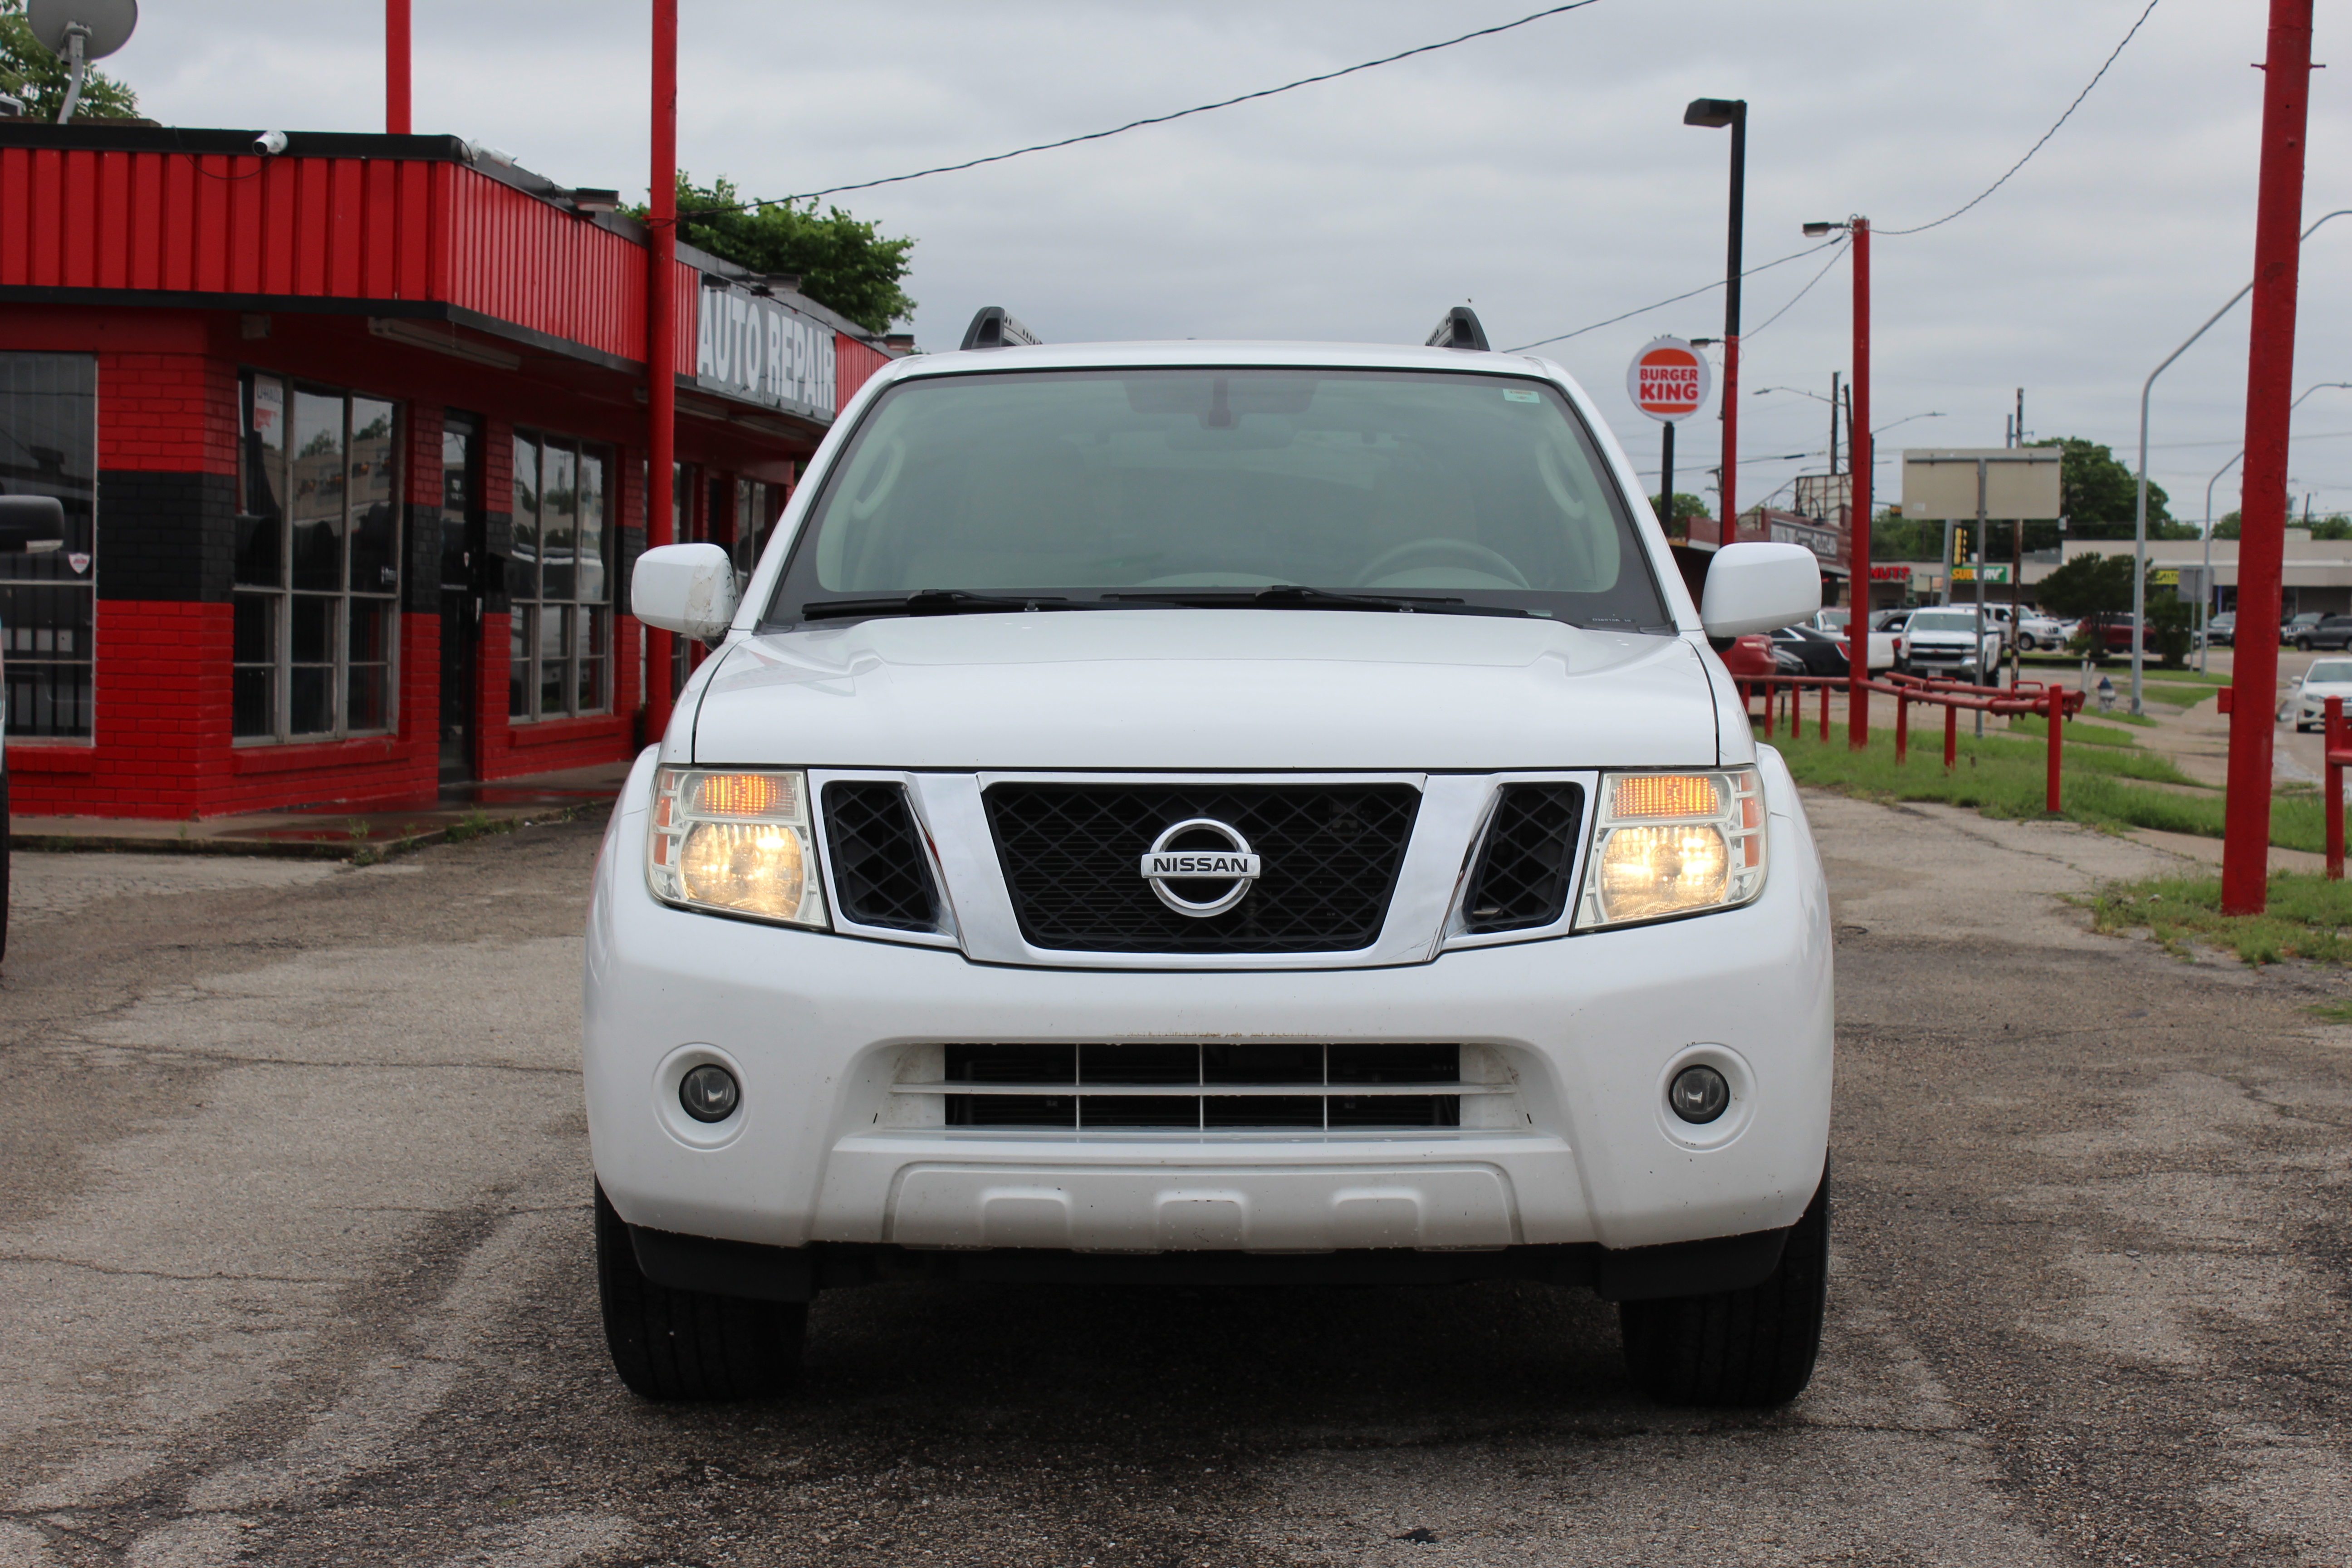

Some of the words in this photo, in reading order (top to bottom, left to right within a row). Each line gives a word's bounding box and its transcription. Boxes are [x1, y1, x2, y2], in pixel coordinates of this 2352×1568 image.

[697, 284, 761, 392] AUTO
[767, 309, 836, 412] REPAIR
[1640, 368, 1698, 381] BURGER
[1640, 382, 1698, 400] KING
[1154, 858, 1248, 872] NISSAN
